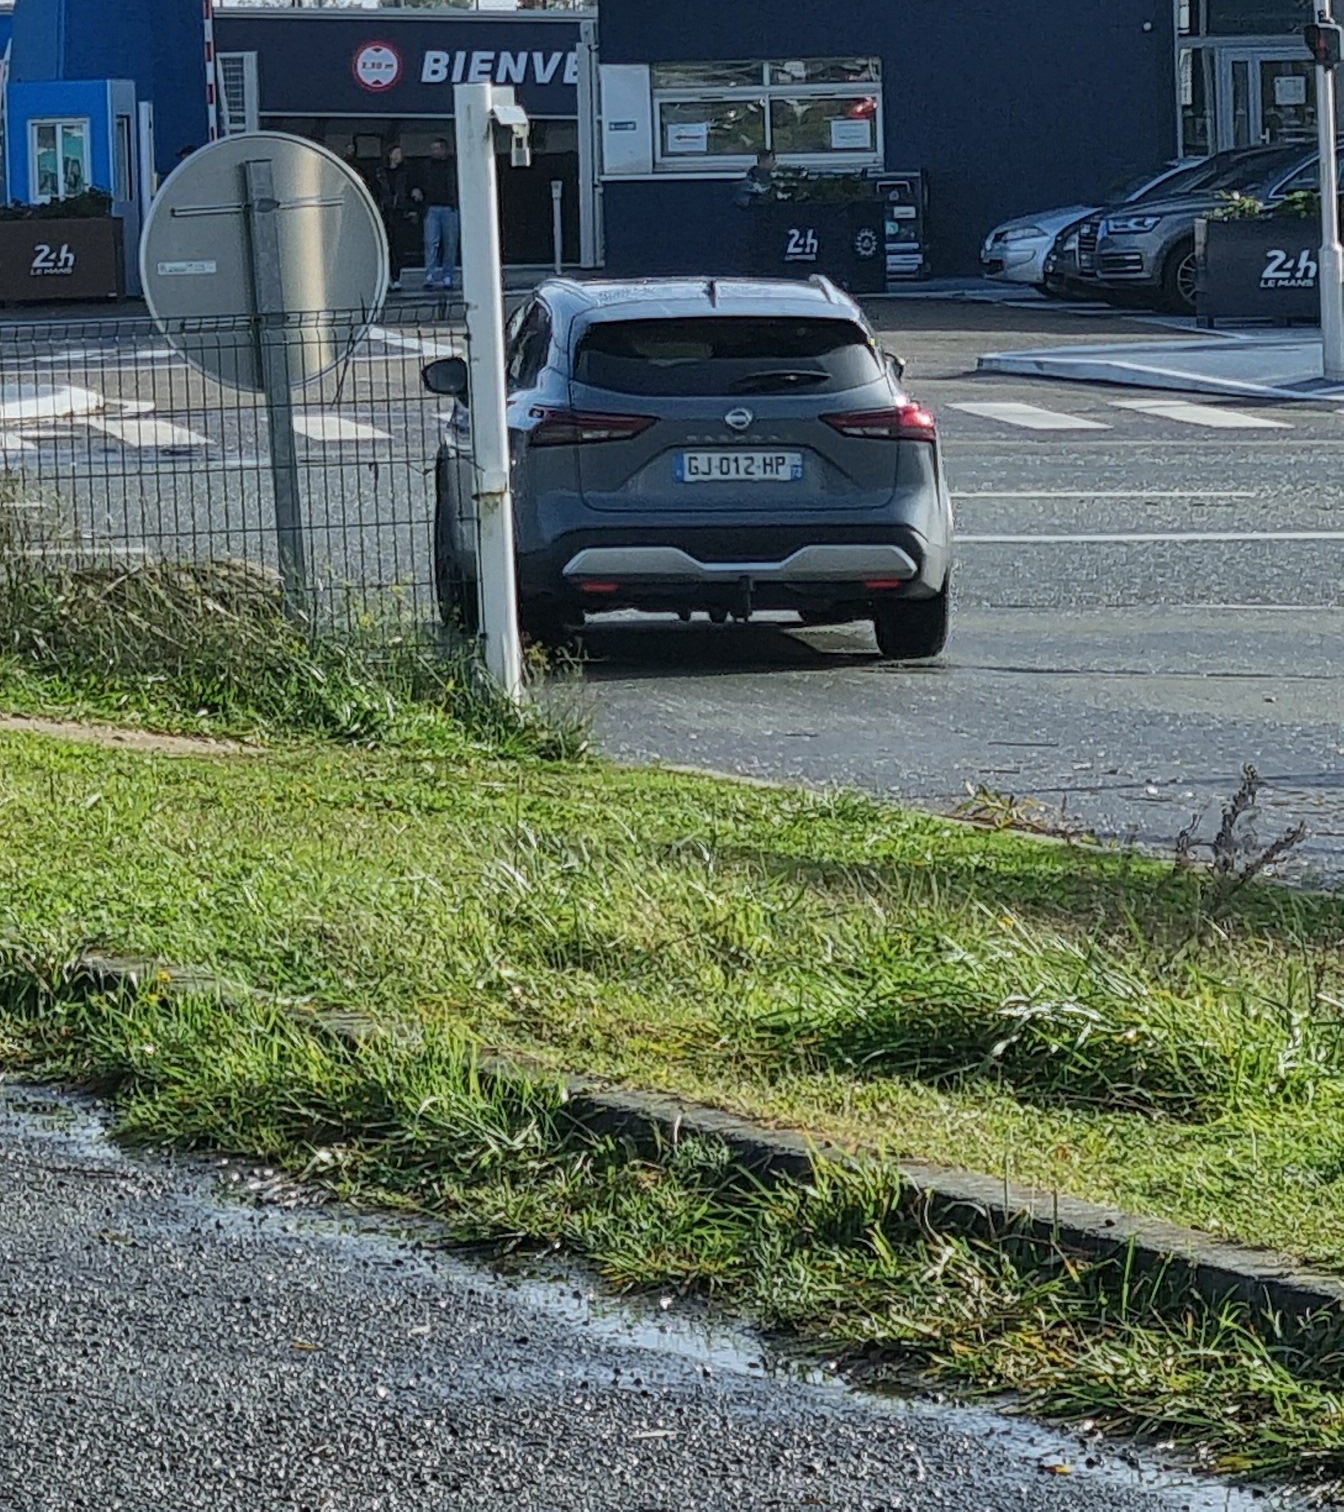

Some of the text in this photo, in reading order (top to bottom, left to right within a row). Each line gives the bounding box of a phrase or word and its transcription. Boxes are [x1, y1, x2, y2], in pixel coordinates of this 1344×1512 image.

[1261, 249, 1318, 279] 24h
[1259, 279, 1314, 288] LE MANS
